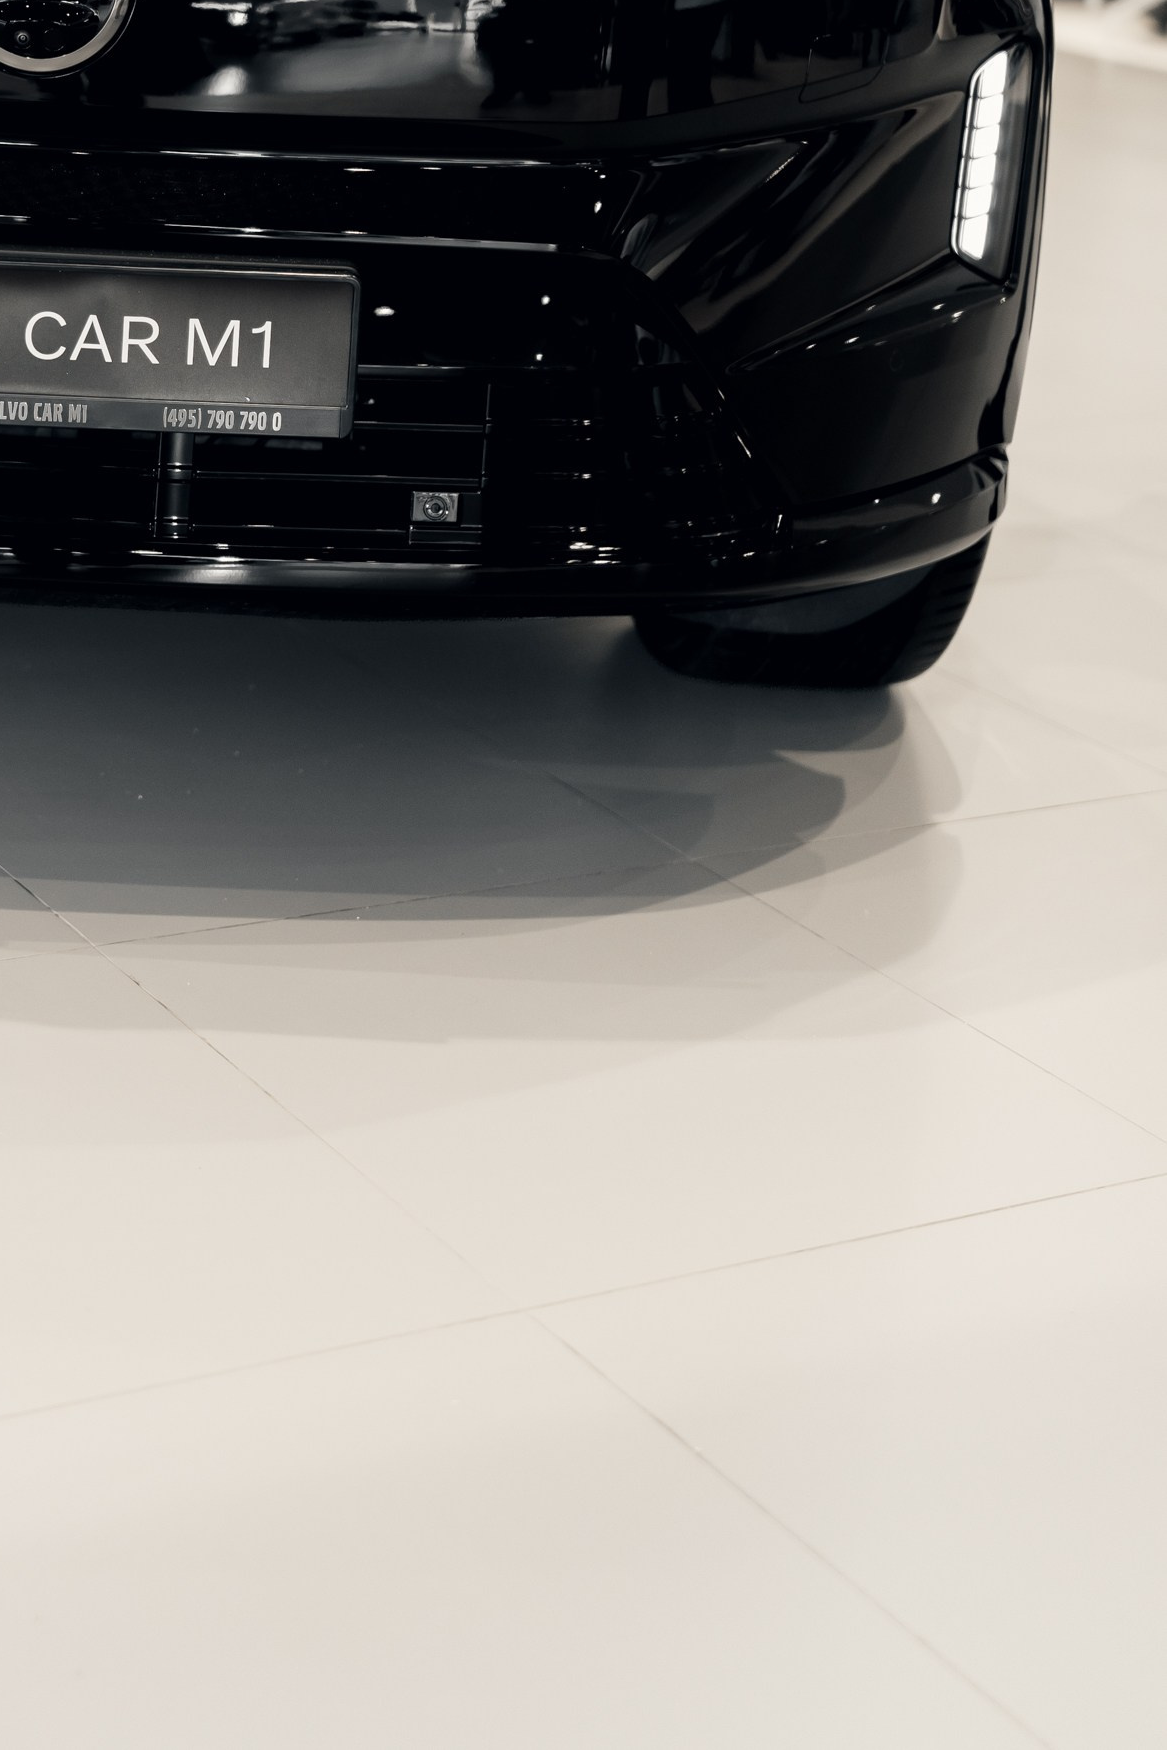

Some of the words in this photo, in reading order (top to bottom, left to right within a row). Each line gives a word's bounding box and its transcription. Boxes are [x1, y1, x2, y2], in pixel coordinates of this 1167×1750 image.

[24, 311, 160, 365] CAR
[186, 318, 272, 369] M1
[33, 402, 63, 423] CAR
[162, 406, 202, 430] (495)
[207, 409, 235, 430] 790
[239, 410, 268, 431] 790
[271, 411, 282, 432] 0
